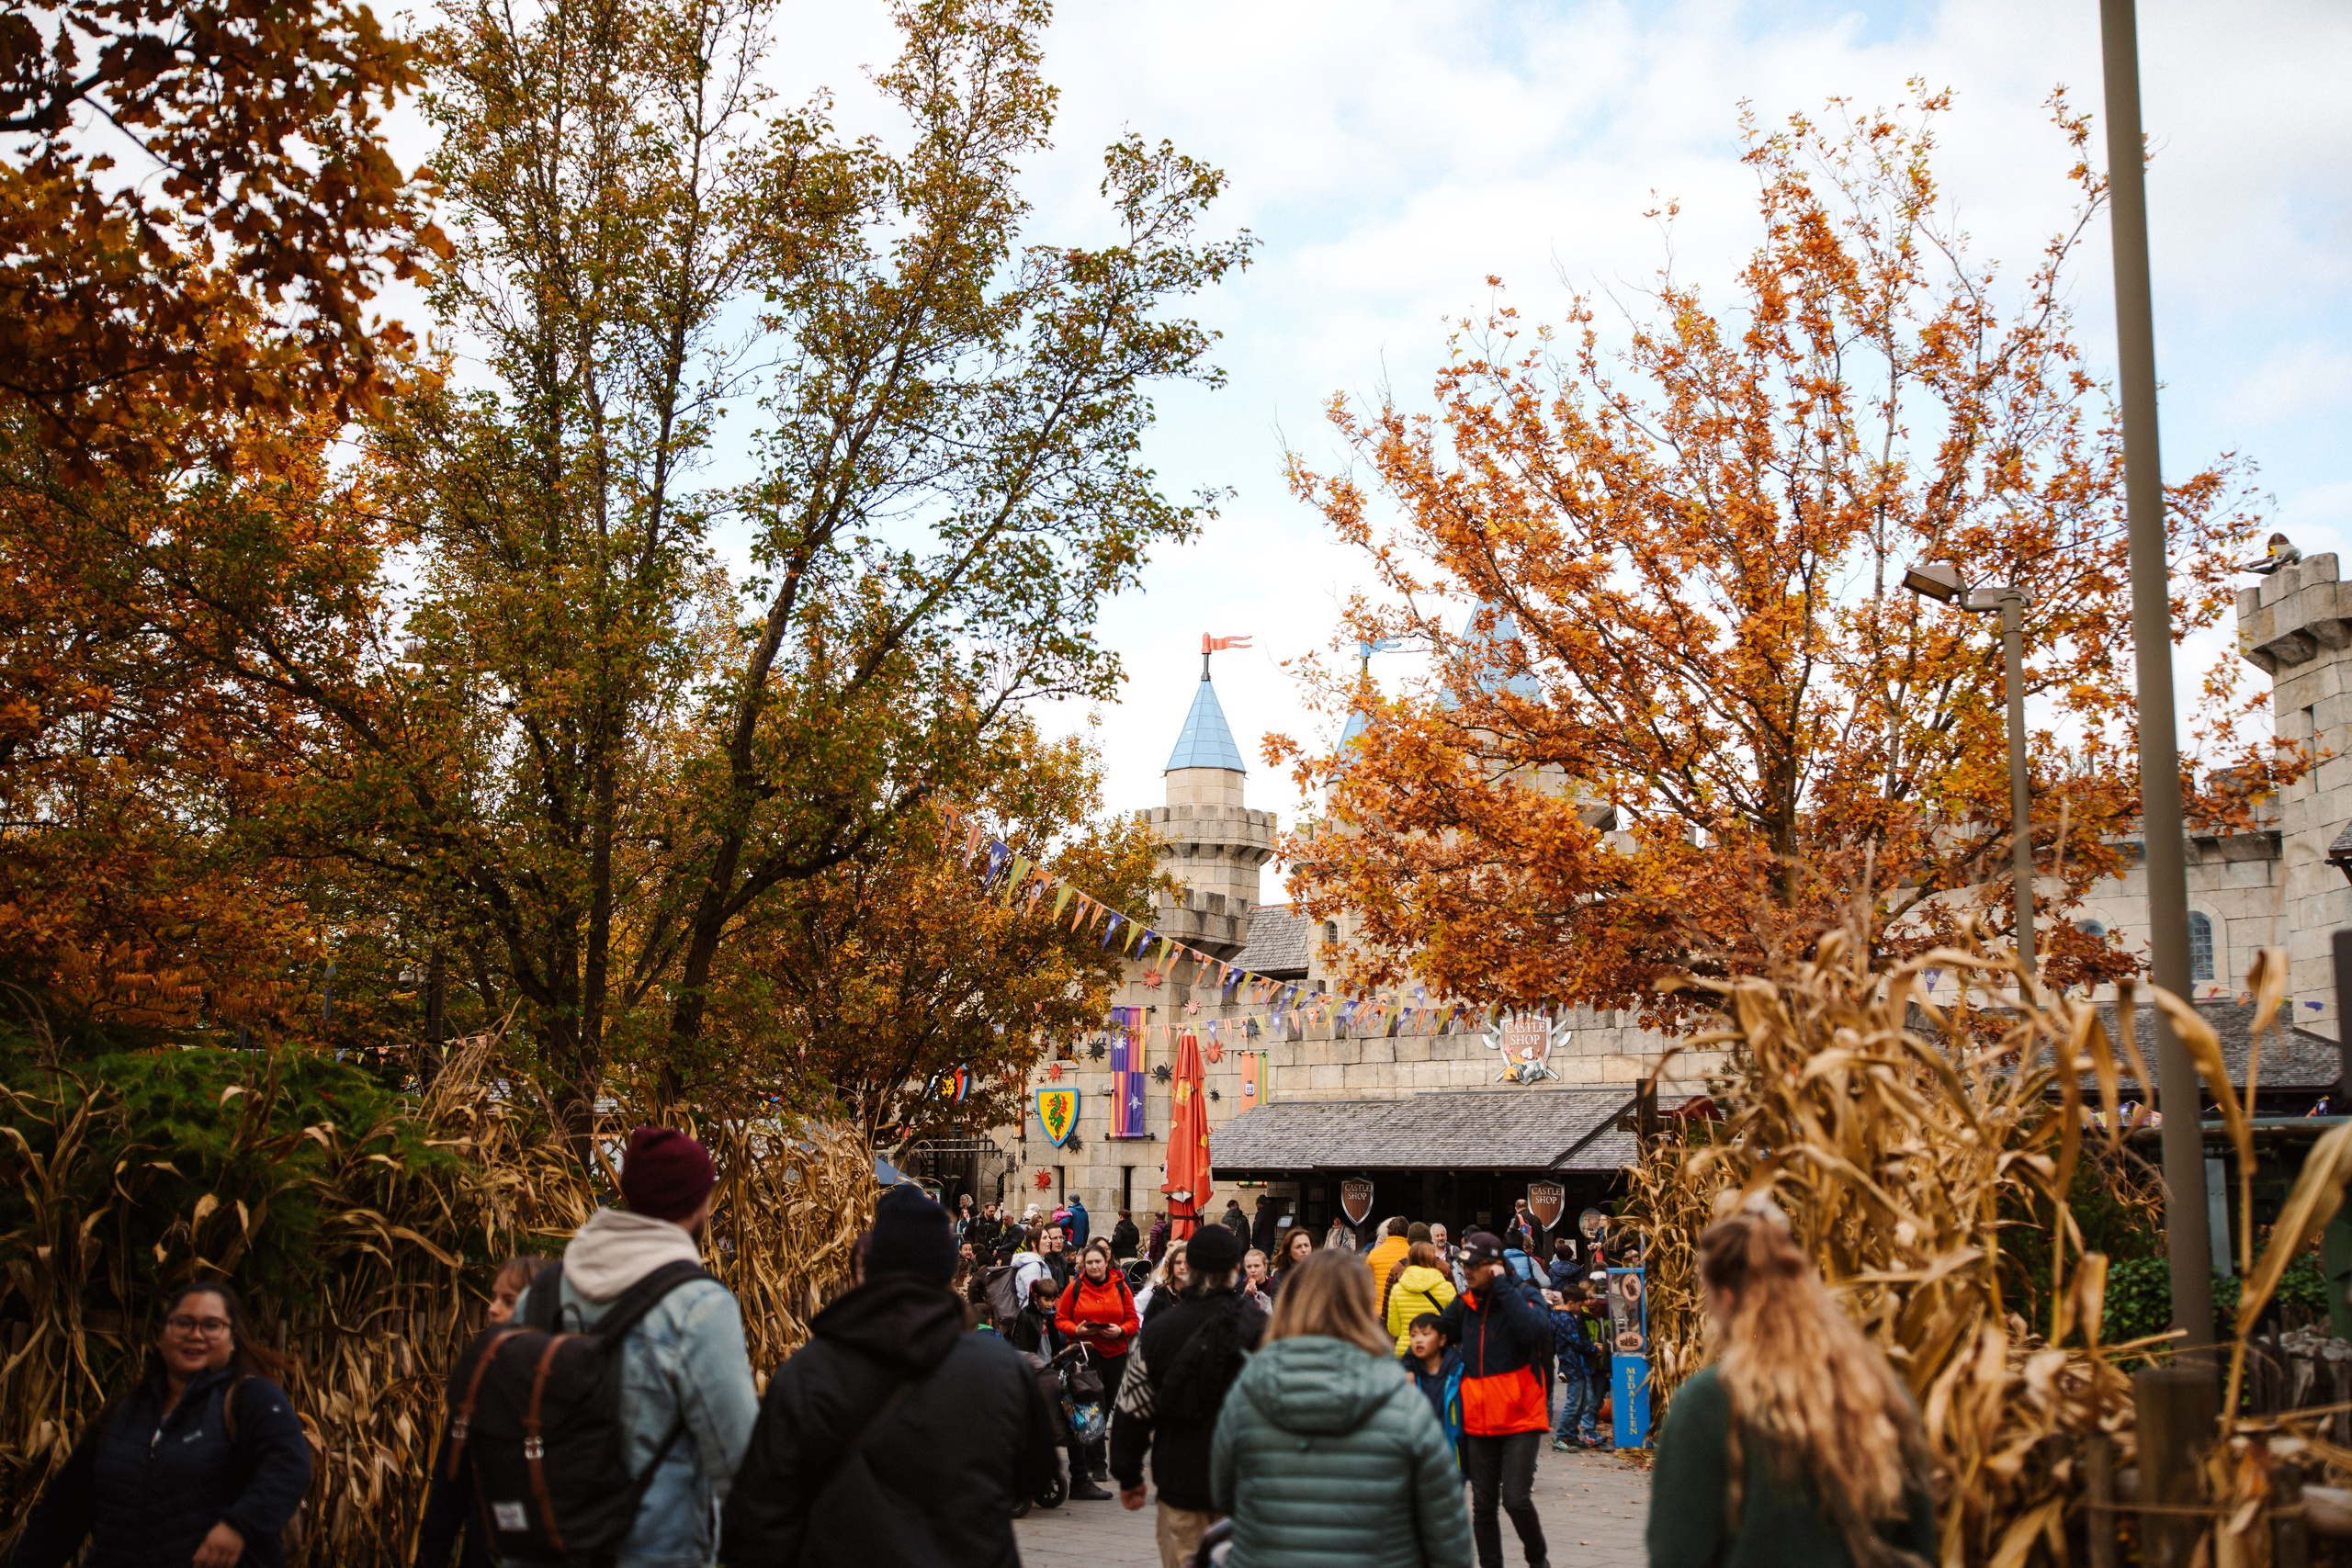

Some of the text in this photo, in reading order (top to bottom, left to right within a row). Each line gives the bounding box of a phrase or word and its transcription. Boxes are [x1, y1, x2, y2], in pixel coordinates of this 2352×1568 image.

[1505, 1022, 1545, 1033] CASTLE
[1510, 1034, 1540, 1045] SHOP
[1531, 1187, 1561, 1195] CASTLE
[1535, 1196, 1557, 1204] SHOP
[1626, 1367, 1637, 1435] MEDAILLEN
